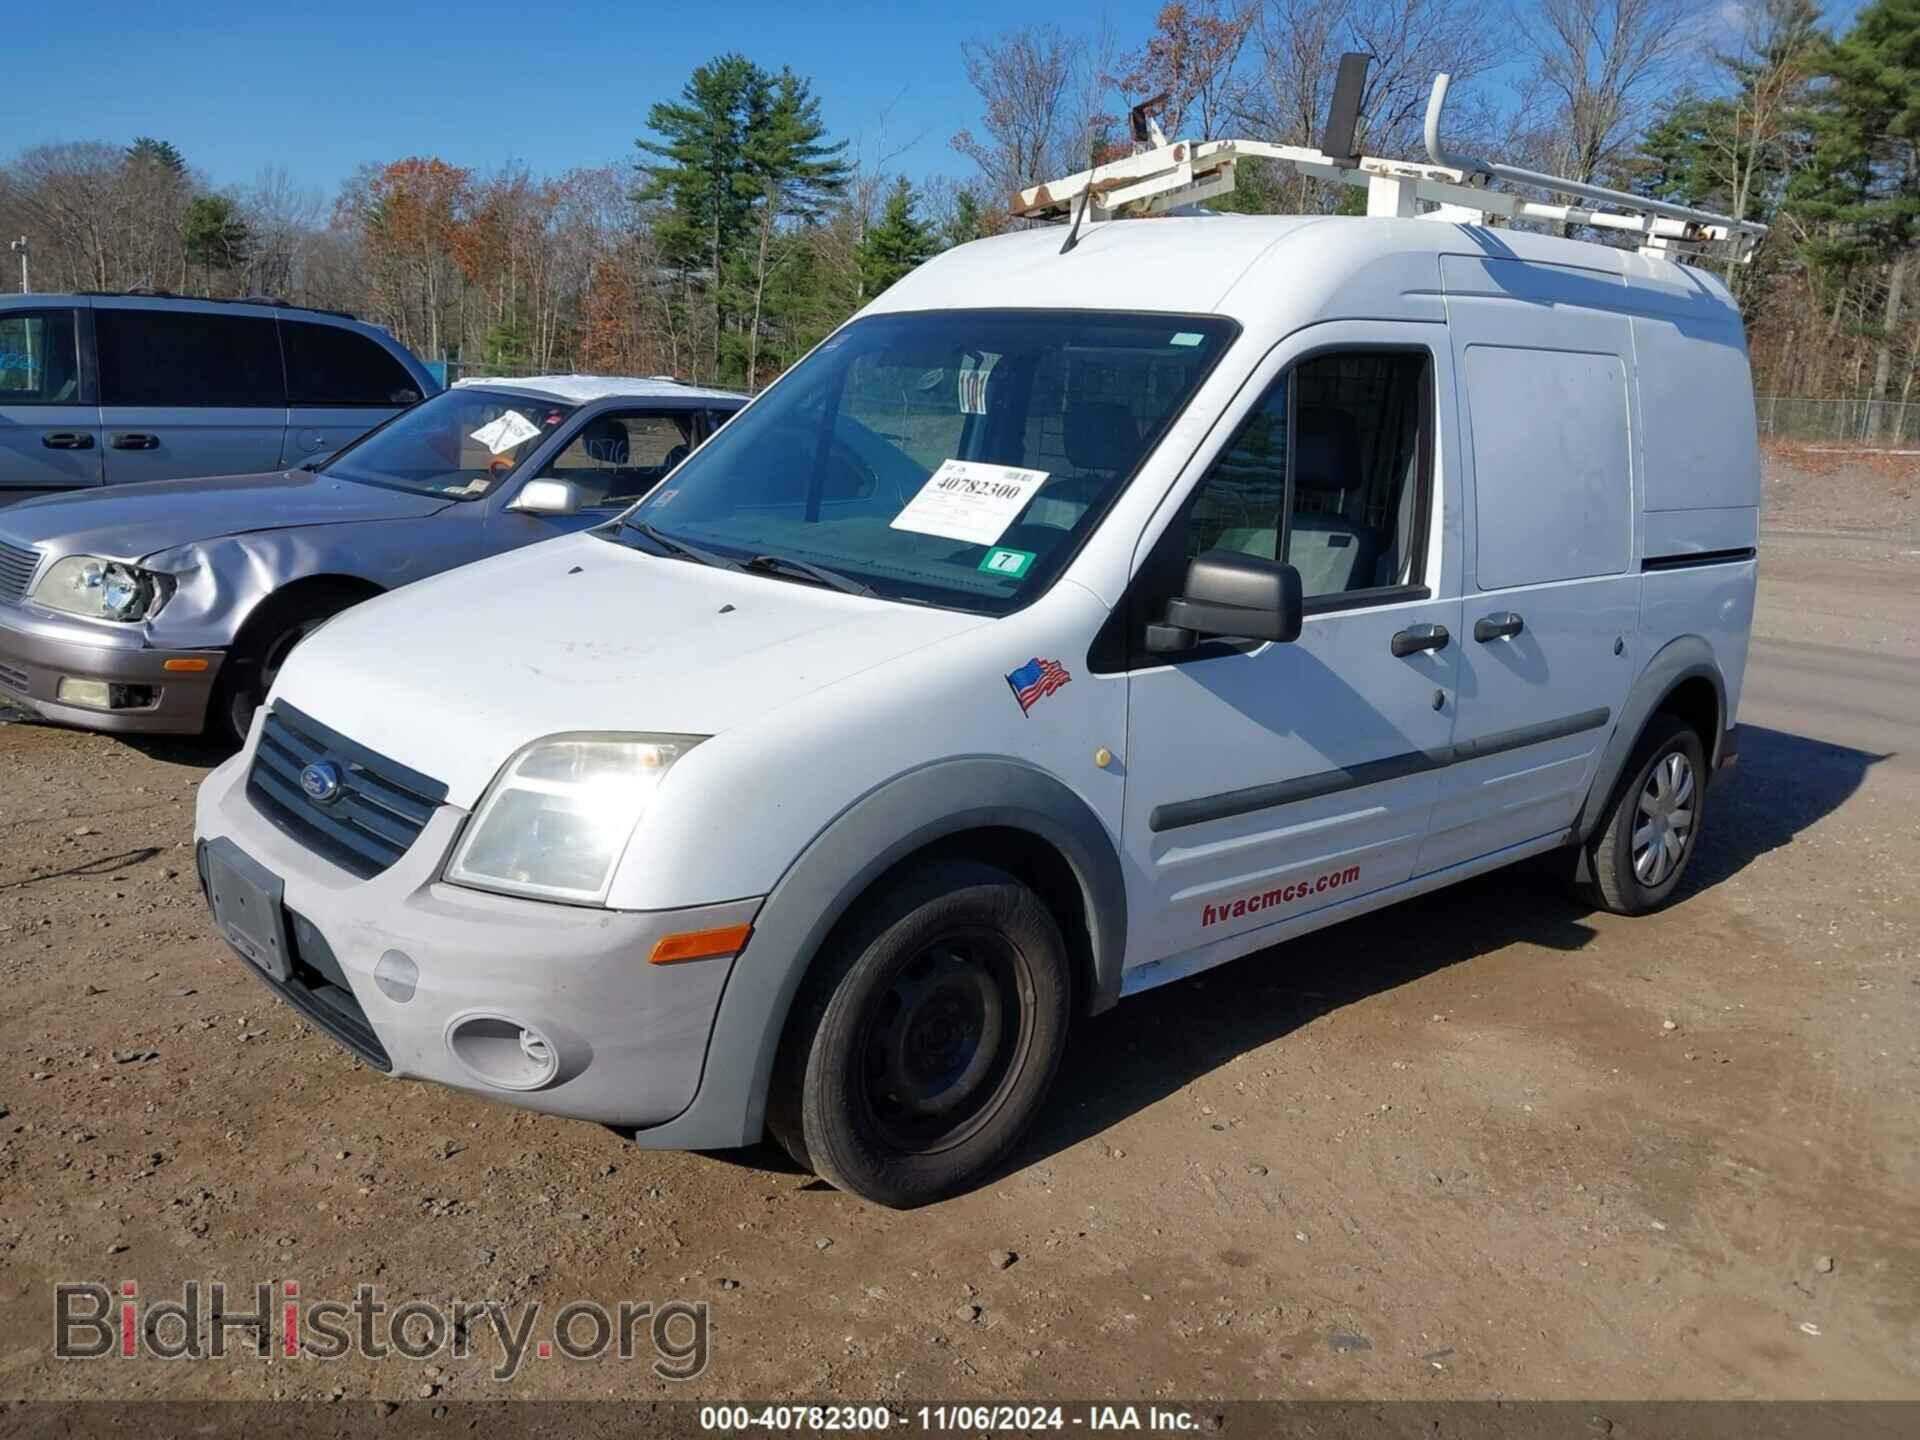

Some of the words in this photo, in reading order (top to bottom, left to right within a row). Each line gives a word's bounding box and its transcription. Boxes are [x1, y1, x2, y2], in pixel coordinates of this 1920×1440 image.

[938, 477, 1020, 499] 40782300
[998, 554, 1011, 567] 7
[1202, 865, 1361, 926] hvacmcs.com
